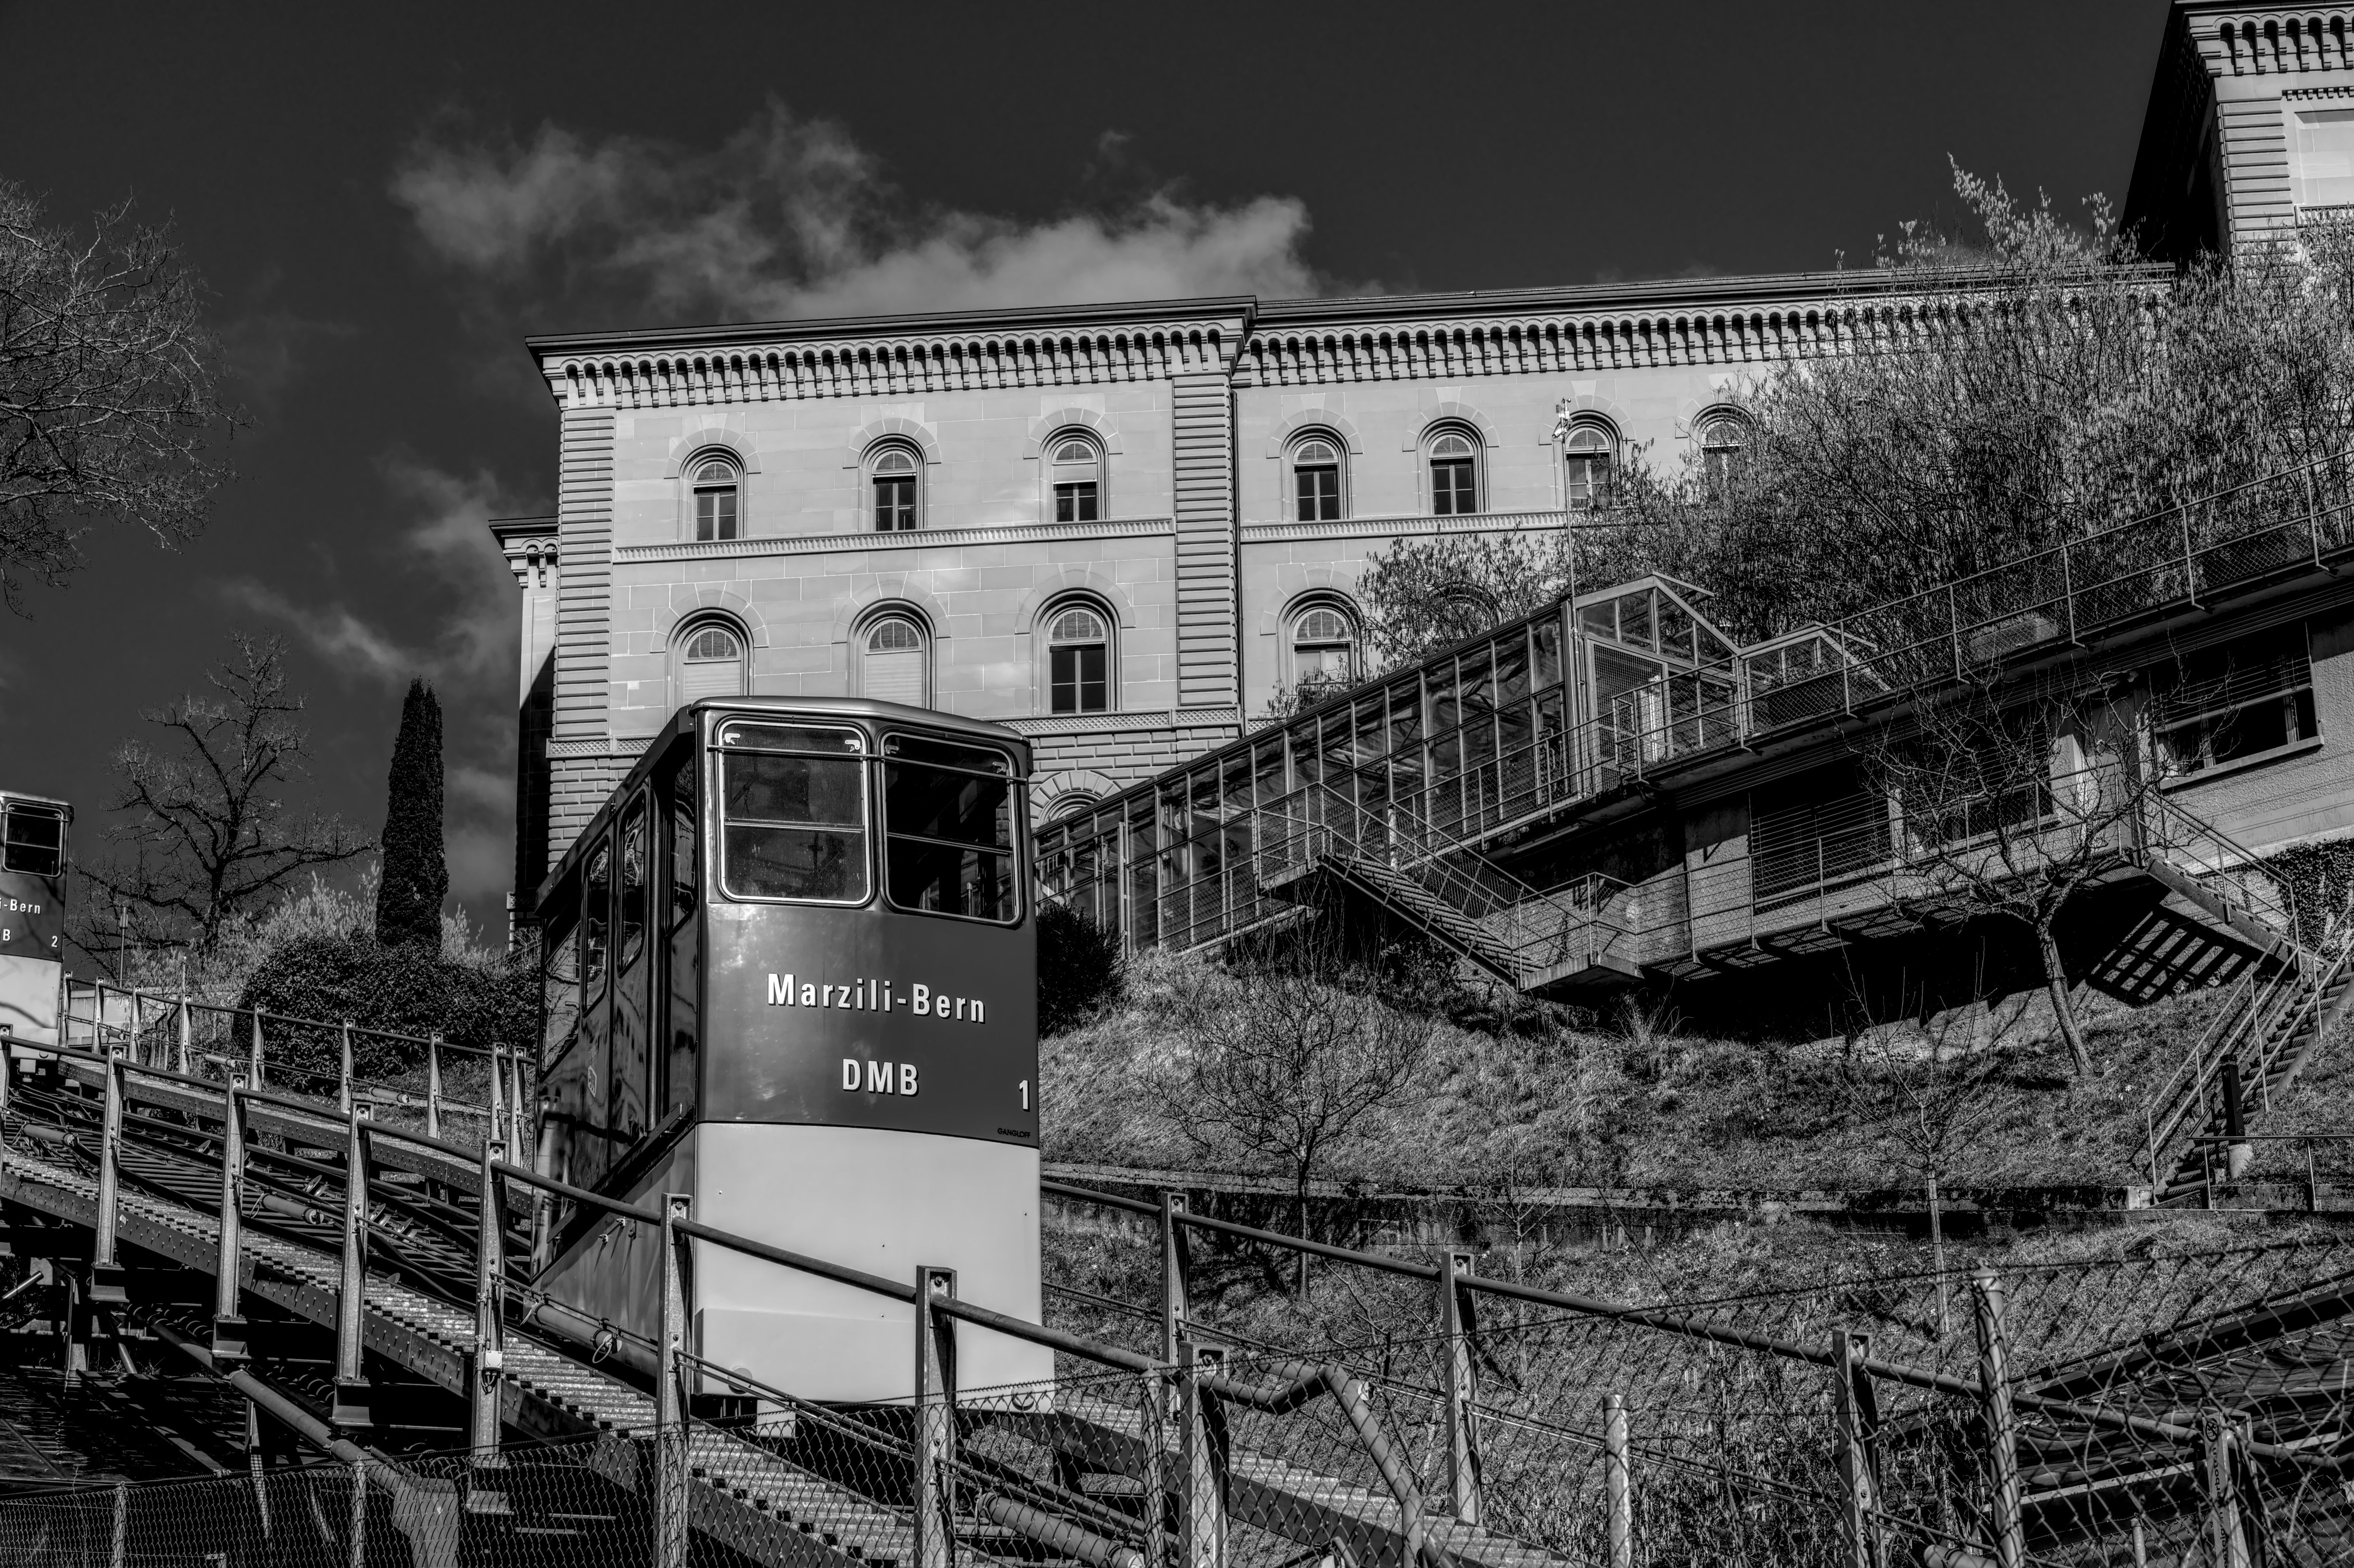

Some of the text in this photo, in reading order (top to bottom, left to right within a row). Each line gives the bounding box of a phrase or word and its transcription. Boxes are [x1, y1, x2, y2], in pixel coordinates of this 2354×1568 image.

[51, 935, 58, 948] 2
[767, 973, 985, 1023] Marzili-Bern
[842, 1058, 919, 1097] DMB
[1019, 1079, 1030, 1112] 1
[997, 1127, 1031, 1138] GANGLOFF
